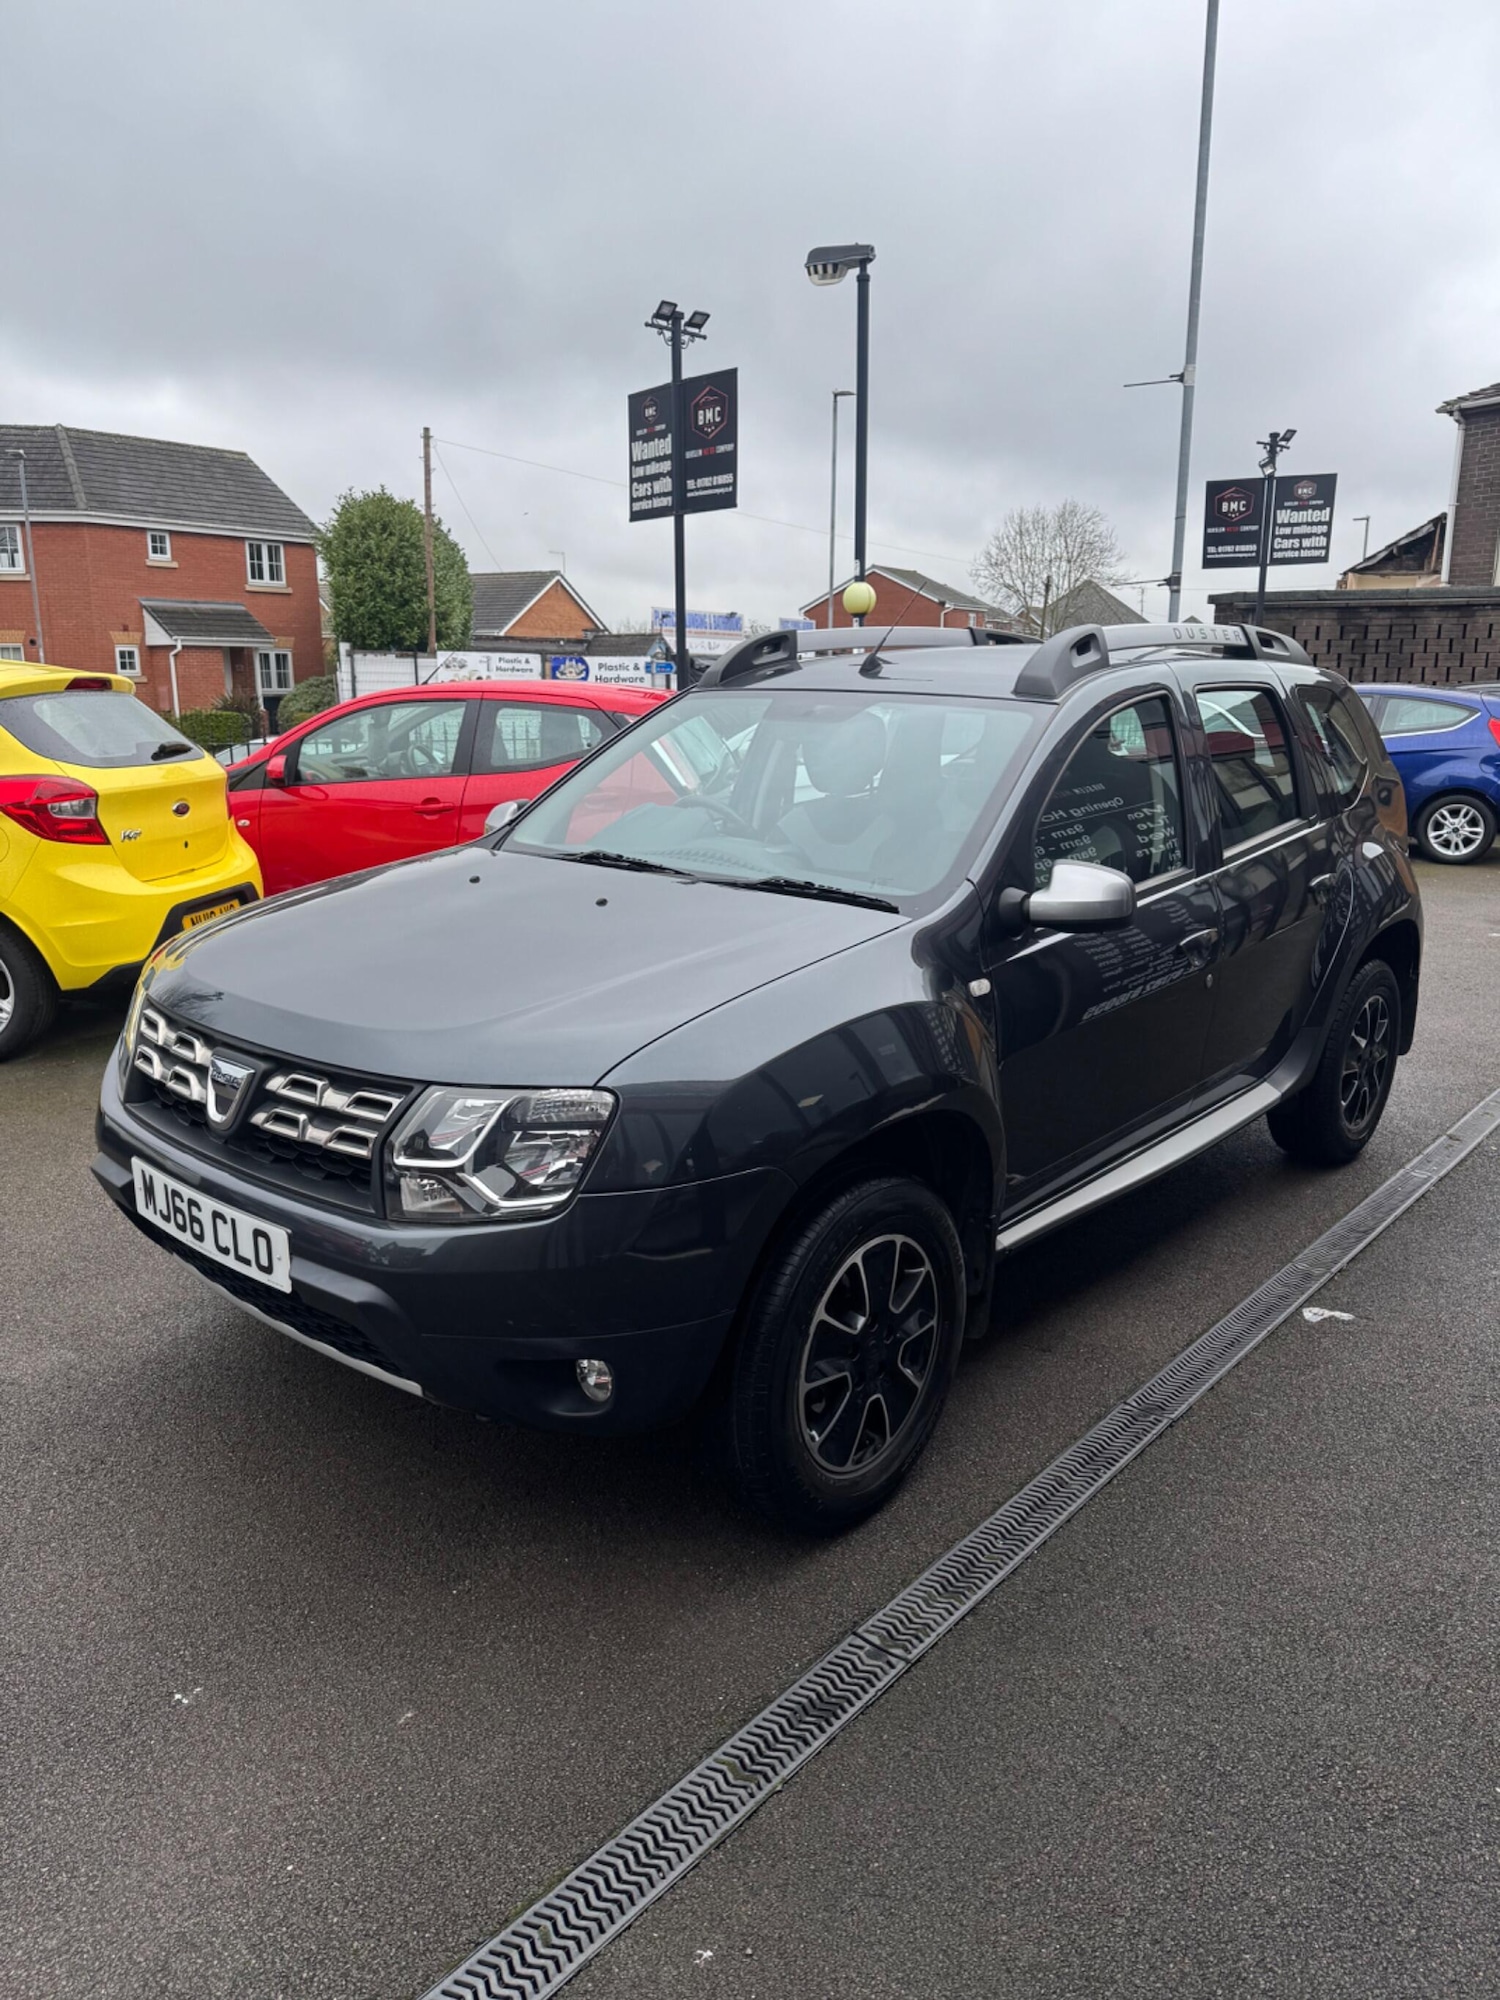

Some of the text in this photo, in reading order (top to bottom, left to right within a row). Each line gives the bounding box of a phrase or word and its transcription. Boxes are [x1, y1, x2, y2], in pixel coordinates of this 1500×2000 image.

[698, 406, 721, 425] BMC
[631, 433, 672, 462] Wanted
[632, 460, 672, 478] Low mileage
[632, 482, 652, 498] Cars
[652, 476, 672, 494] with
[632, 496, 672, 511] service history
[1222, 500, 1247, 513] BMC
[1276, 506, 1331, 524] Wanted
[1275, 525, 1328, 535] Low mileage
[1273, 535, 1327, 549] Cars with
[1272, 549, 1326, 559] service history
[1173, 628, 1242, 641] DUSTER
[498, 656, 523, 665] Plastic
[598, 662, 631, 672] Plastic
[633, 662, 640, 672] &
[496, 665, 534, 674] Hardware
[595, 674, 645, 684] Hardware
[141, 1169, 273, 1275] MJ66 CLO
